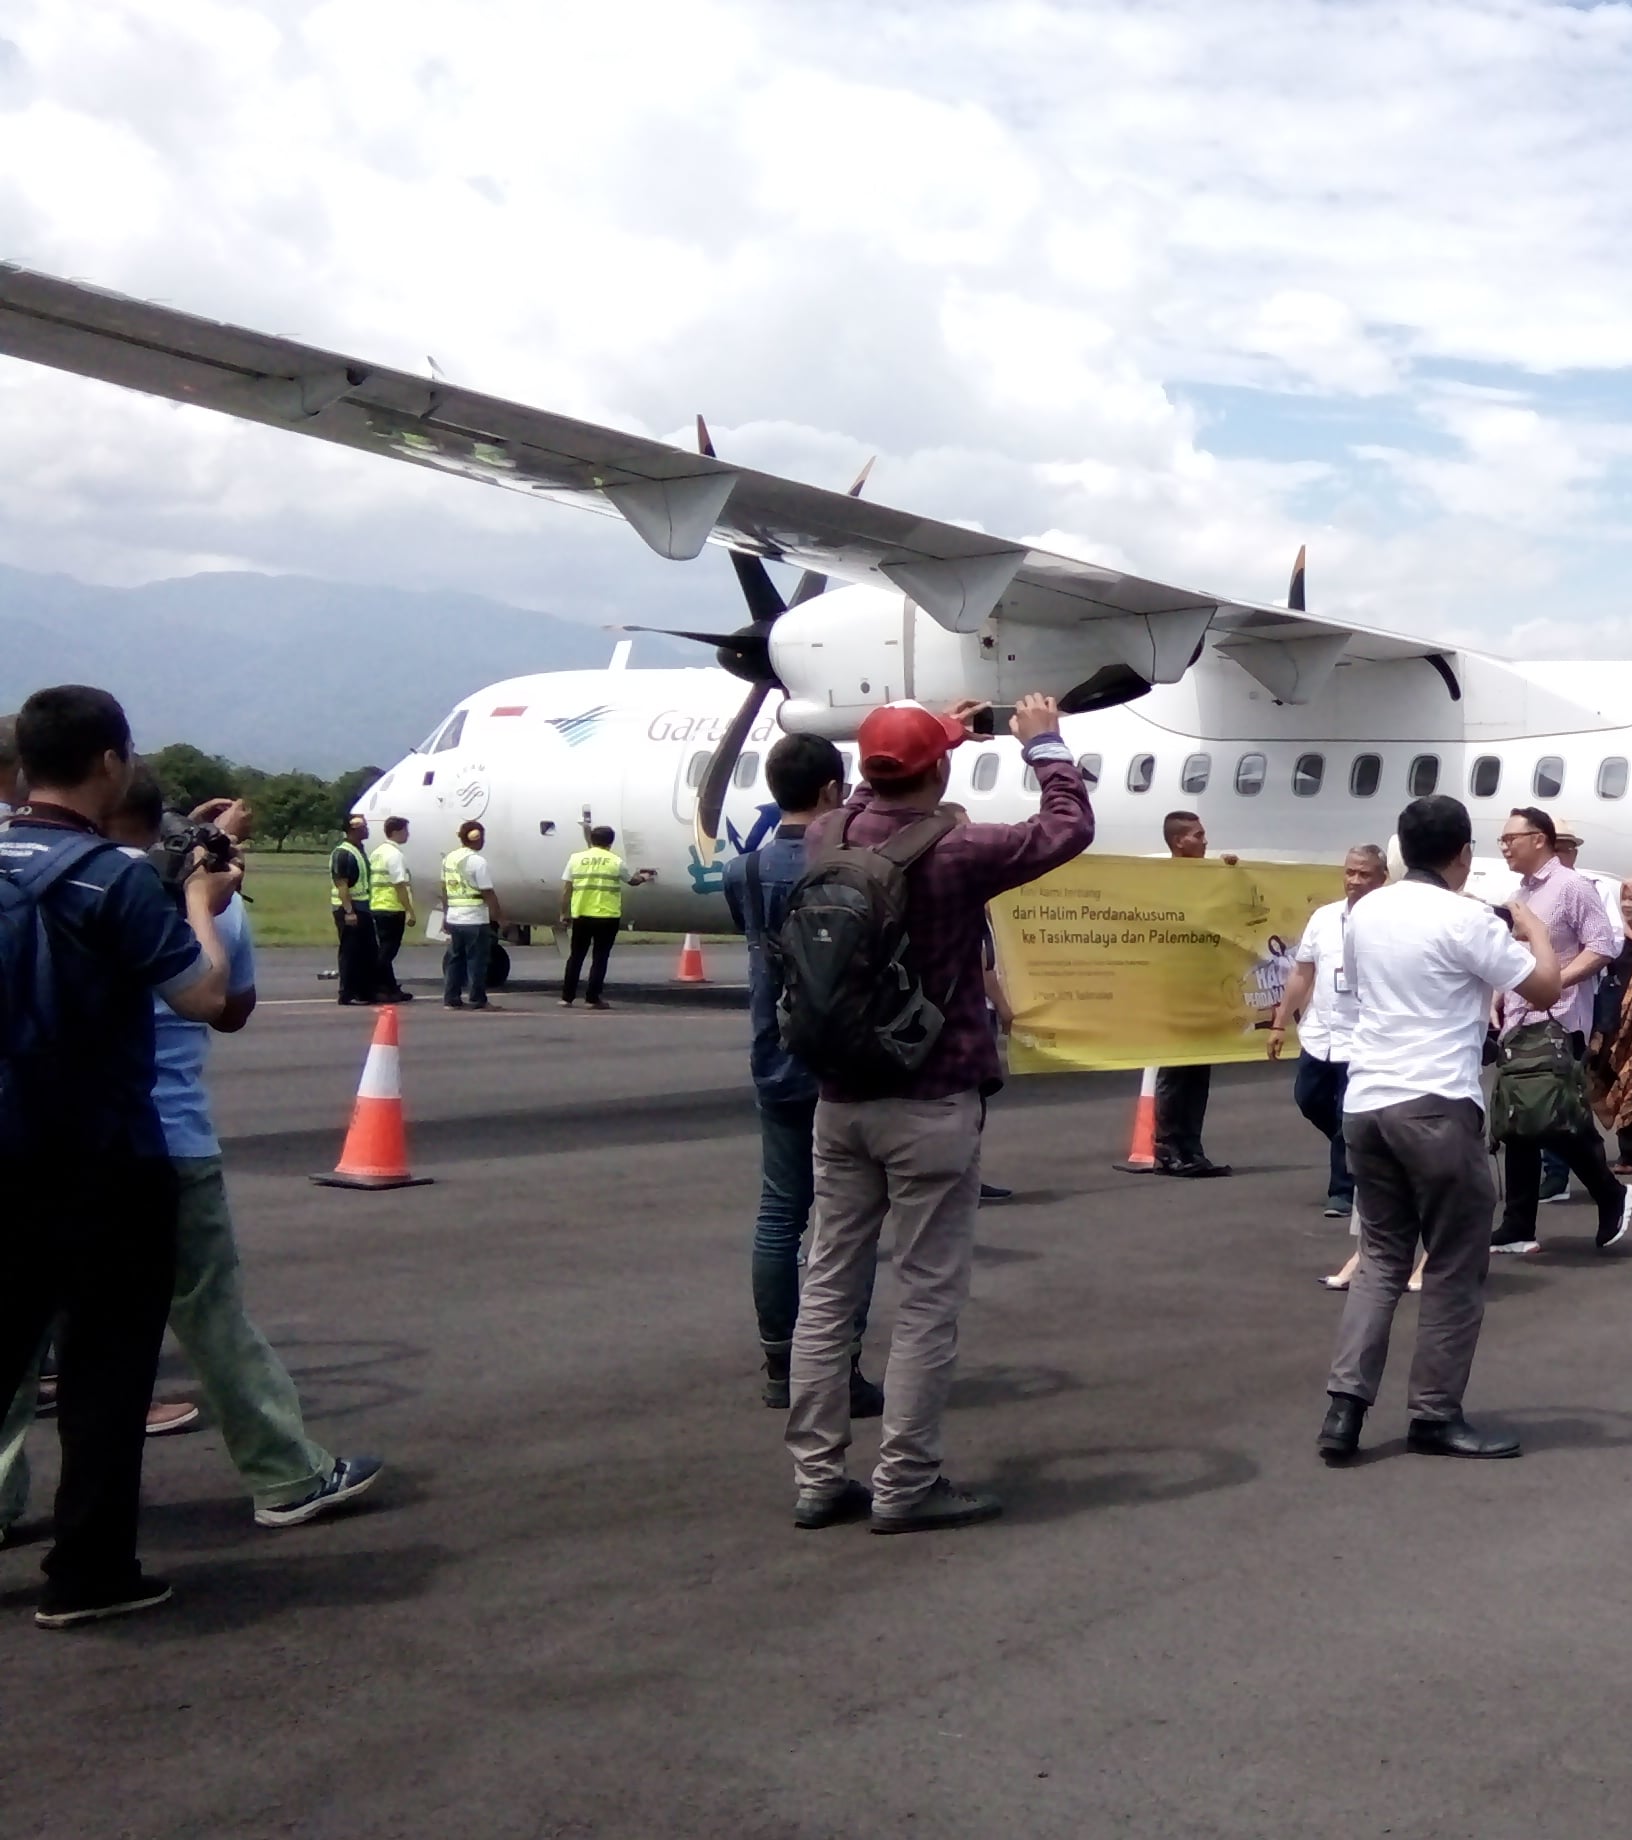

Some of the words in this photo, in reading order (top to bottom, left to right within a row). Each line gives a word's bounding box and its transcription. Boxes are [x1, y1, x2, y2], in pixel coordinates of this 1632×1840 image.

[647, 709, 775, 742] Garua
[581, 857, 611, 866] GMF
[1012, 904, 1036, 920] dari
[1040, 905, 1078, 921] Halim
[1081, 905, 1185, 922] Perdanakusuma
[1021, 928, 1036, 944] ke
[1039, 928, 1117, 949] Tasikmalaya
[1120, 928, 1145, 944] dan
[1149, 929, 1221, 948] Palembang
